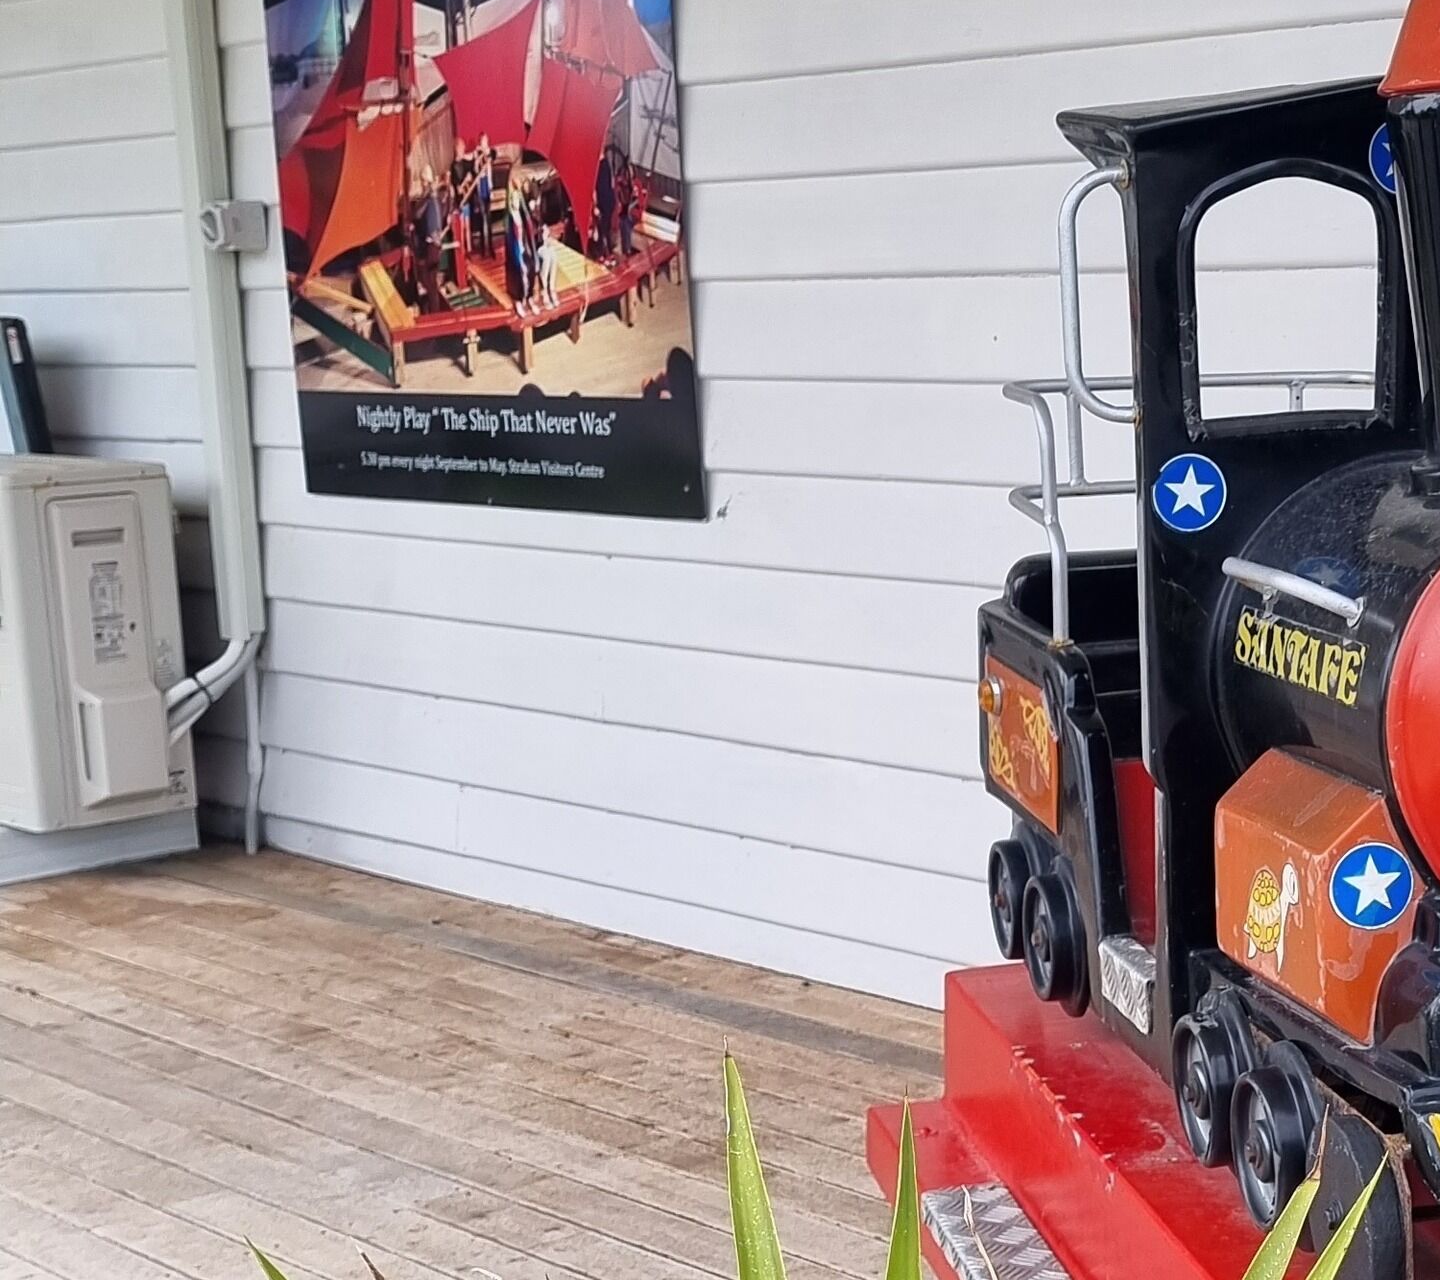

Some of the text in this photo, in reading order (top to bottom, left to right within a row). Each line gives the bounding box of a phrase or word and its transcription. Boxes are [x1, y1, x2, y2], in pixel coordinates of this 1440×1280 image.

[356, 404, 401, 434] Nightly
[403, 405, 431, 435] Play
[468, 407, 500, 438] Ship
[500, 408, 534, 433] That
[535, 409, 578, 434] Never
[391, 455, 414, 472] every
[414, 454, 435, 473] night
[434, 454, 478, 474] September
[479, 458, 489, 473] to
